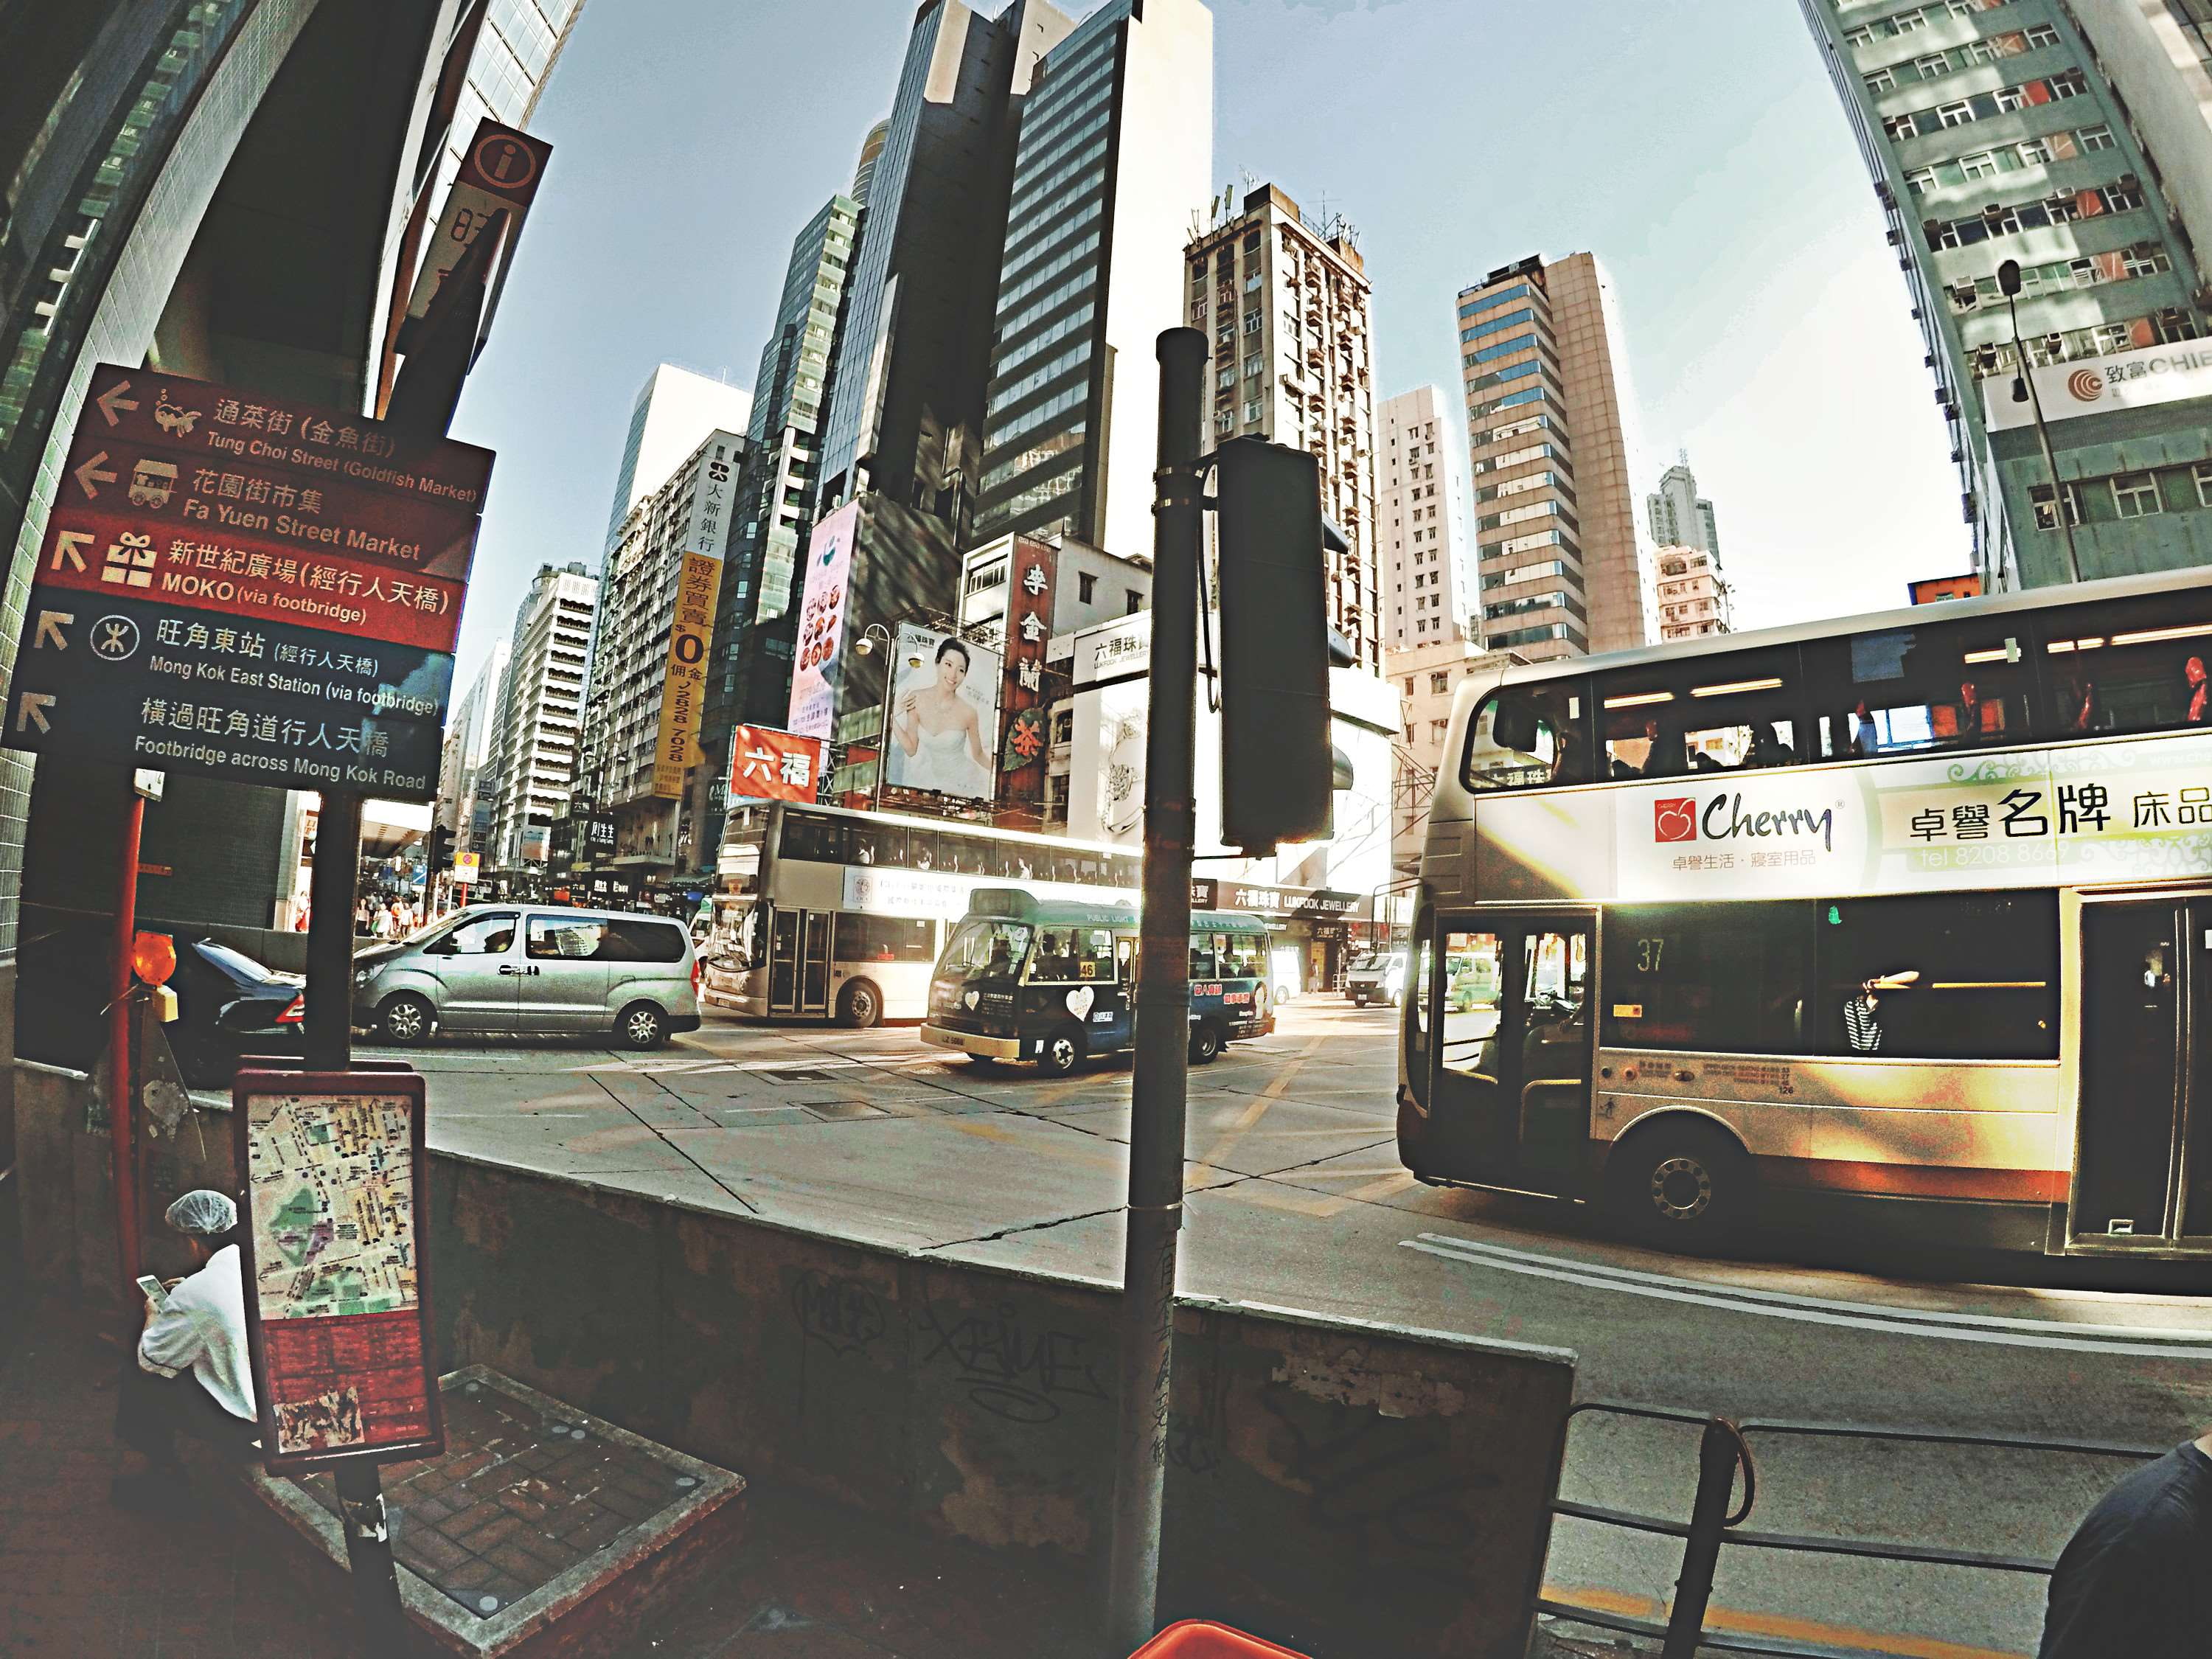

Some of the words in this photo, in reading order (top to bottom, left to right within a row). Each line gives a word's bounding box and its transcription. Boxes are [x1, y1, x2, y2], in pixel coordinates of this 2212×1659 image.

[2104, 361, 2148, 384] 致富
[213, 399, 293, 435] 通菜街
[300, 416, 395, 458] (金魚街)
[192, 469, 323, 515] 花園街市集
[207, 431, 243, 455] Tung
[250, 440, 288, 460] Choi
[291, 448, 340, 471] Street
[344, 460, 414, 489] (Goldfish
[419, 477, 476, 503] Market)
[184, 499, 210, 520] Fa
[218, 504, 268, 531] Yuen
[275, 518, 341, 544] Street
[347, 529, 420, 561] Market
[698, 484, 723, 552] 大新銀行
[161, 571, 234, 602] MOKO
[237, 585, 269, 606] (via
[273, 593, 367, 625] footbridge)
[156, 619, 265, 659] 旺角東站
[274, 643, 378, 678] (經行人天橋)
[671, 664, 703, 681] 佣金
[150, 655, 192, 680] Mong
[197, 662, 226, 681] Kok
[230, 669, 264, 686] East
[267, 673, 321, 695] Station
[326, 681, 353, 701] (via
[356, 686, 439, 717] footbridge)
[135, 735, 226, 765] Footbridge
[232, 752, 288, 772] across
[293, 757, 341, 783] Mong
[346, 765, 378, 785] Kok
[383, 771, 426, 790] Road
[742, 748, 811, 787] 六福
[1703, 793, 1832, 852] Cherry
[1921, 849, 1947, 866] tel
[1955, 845, 2010, 865] 8208
[2017, 841, 2070, 862] 8669
[1284, 895, 1319, 910] LUKFOOK
[1320, 900, 1360, 913] JEWELLERY
[1081, 964, 1093, 975] 46
[1637, 938, 1665, 972] 37
[1778, 1085, 1794, 1094] 126
